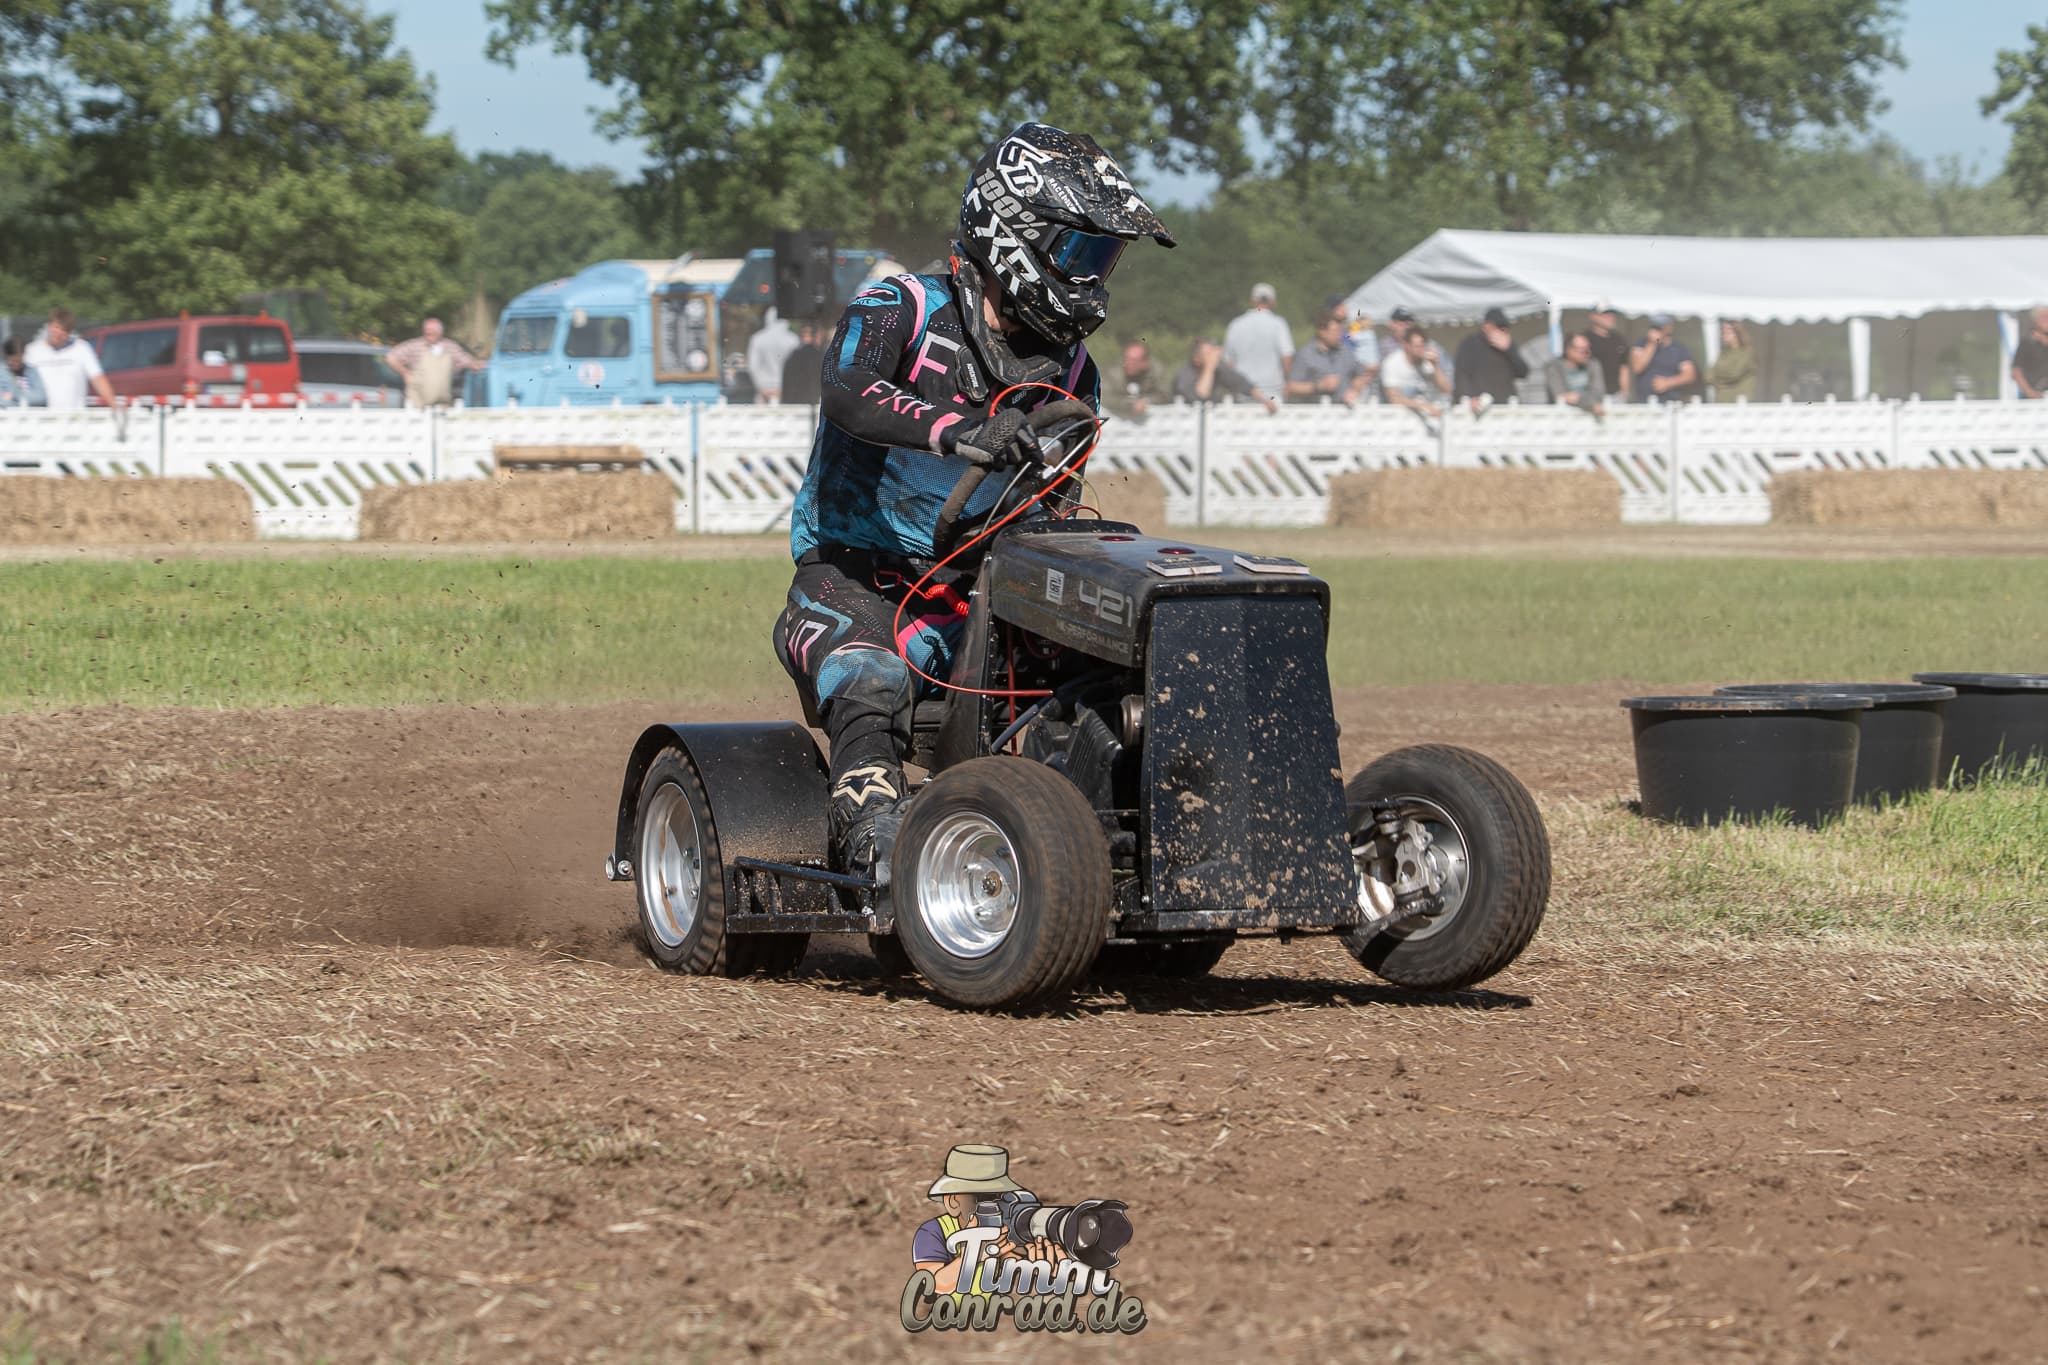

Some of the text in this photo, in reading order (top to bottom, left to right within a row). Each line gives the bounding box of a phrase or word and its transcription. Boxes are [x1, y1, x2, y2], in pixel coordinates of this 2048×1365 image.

[975, 167, 1048, 241] 100%
[861, 379, 937, 420] FXR
[1079, 579, 1133, 628] 421
